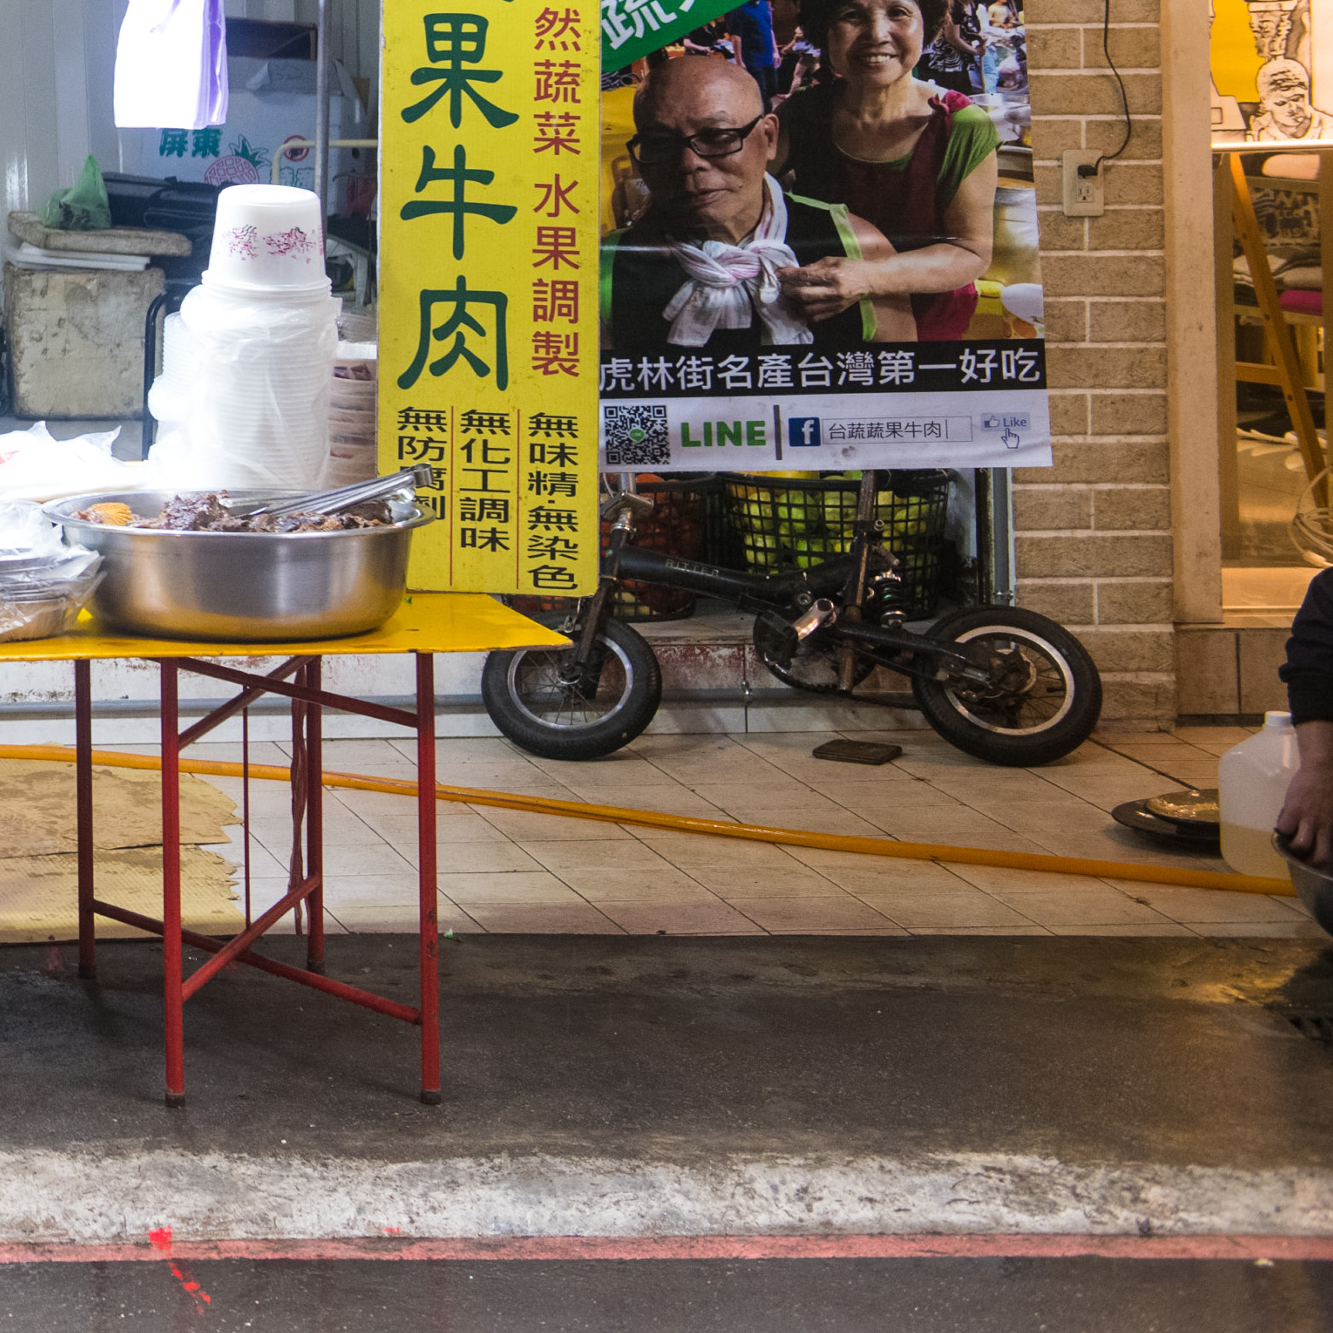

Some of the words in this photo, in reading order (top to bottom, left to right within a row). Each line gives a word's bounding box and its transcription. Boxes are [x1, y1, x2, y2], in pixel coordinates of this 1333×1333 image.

[599, 347, 1041, 393] 虎林街名產台灣第一好吃
[680, 420, 767, 447] LINE
[828, 421, 943, 441] 台蔬蔬果牛肉
[1003, 417, 1027, 427] Like
[459, 409, 511, 553] 無化工調味
